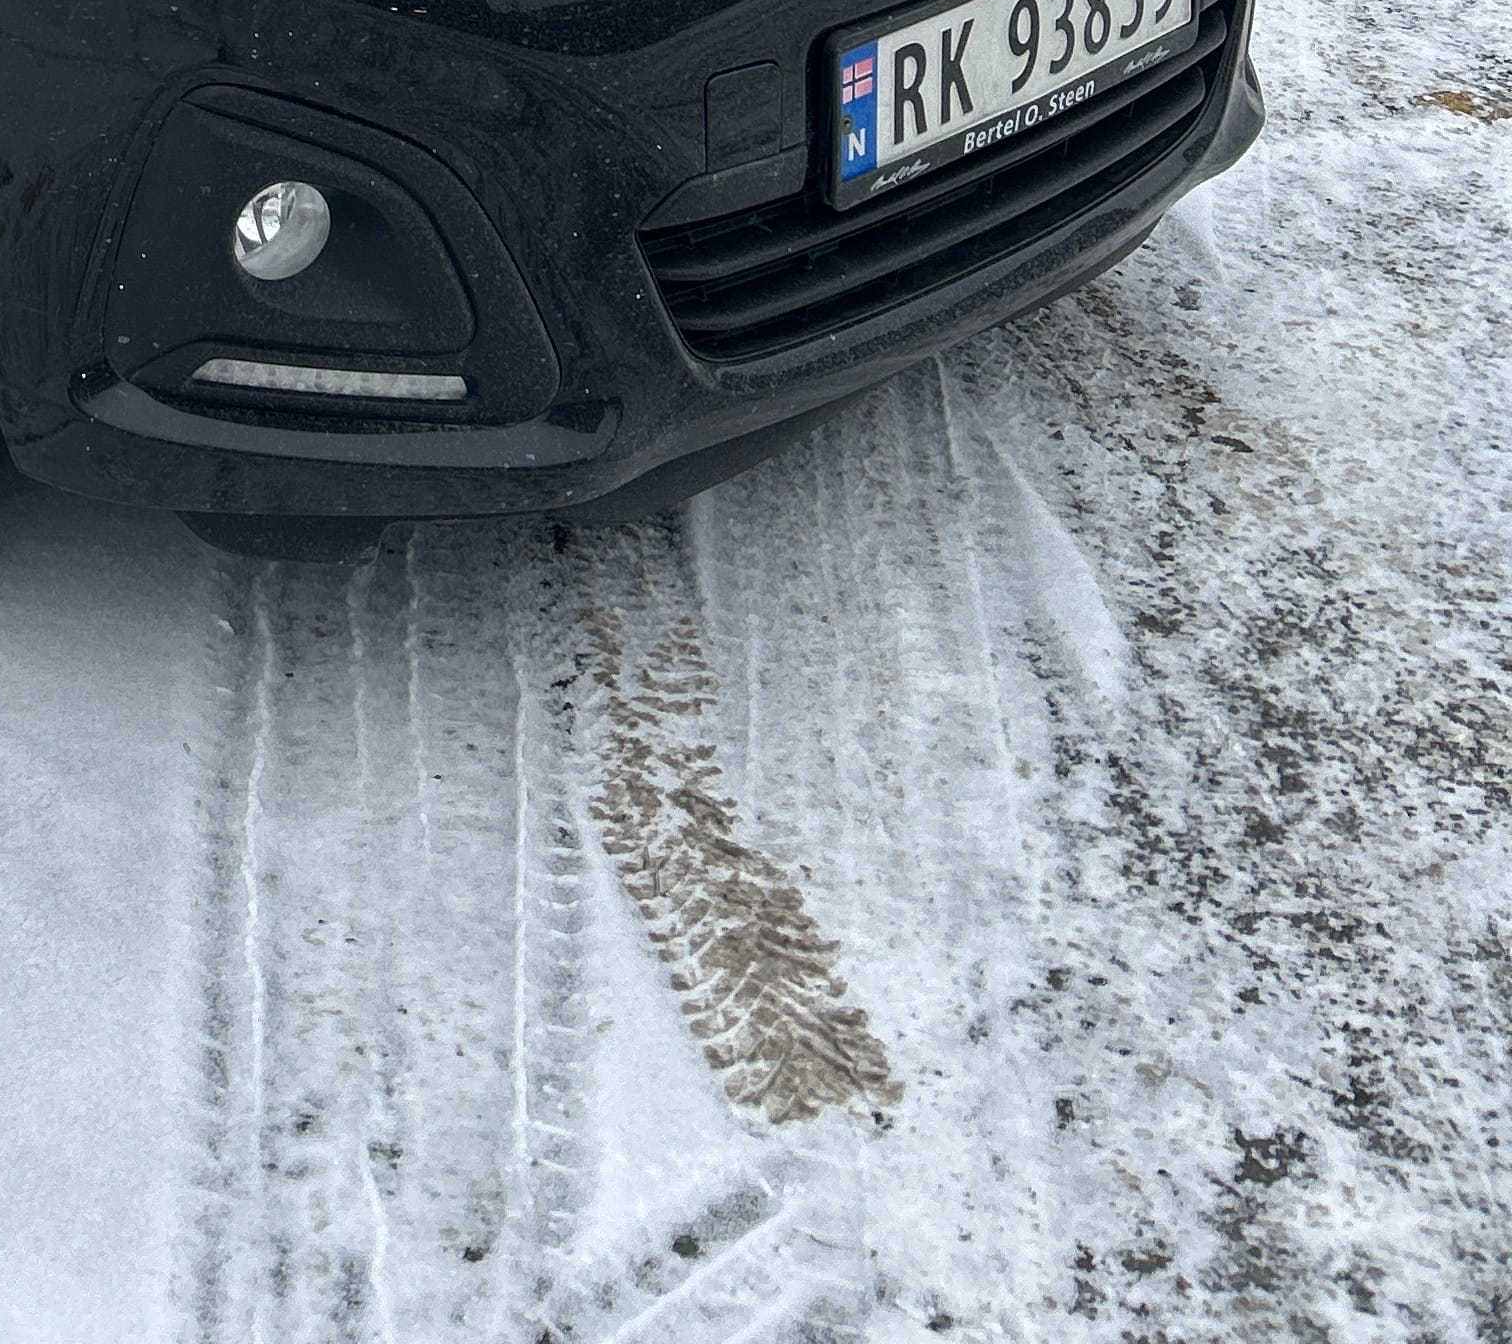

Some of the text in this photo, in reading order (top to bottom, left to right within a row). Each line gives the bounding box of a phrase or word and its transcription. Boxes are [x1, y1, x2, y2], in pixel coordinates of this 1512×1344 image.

[893, 17, 975, 146] RK
[963, 80, 1095, 154] Bertel O. Steen
[848, 127, 866, 161] N
